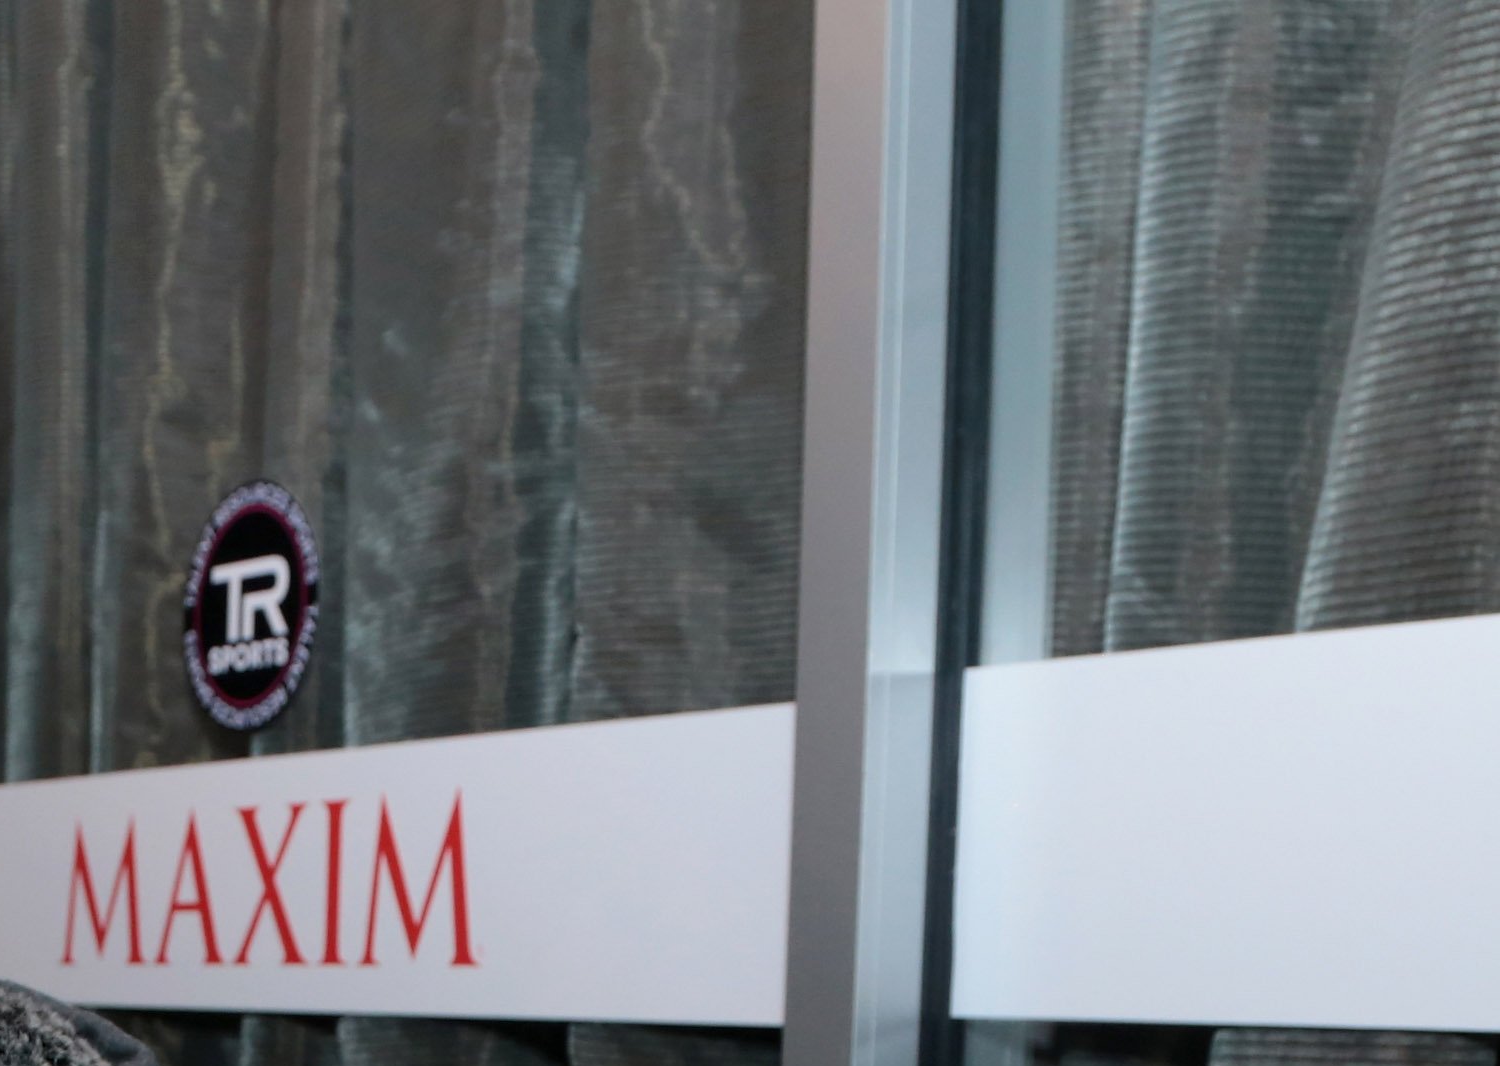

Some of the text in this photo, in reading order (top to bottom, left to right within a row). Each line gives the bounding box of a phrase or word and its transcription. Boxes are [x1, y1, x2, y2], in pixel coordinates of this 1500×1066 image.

[209, 554, 291, 642] TR
[207, 637, 290, 676] SPORTS
[61, 787, 476, 966] MAXIM
